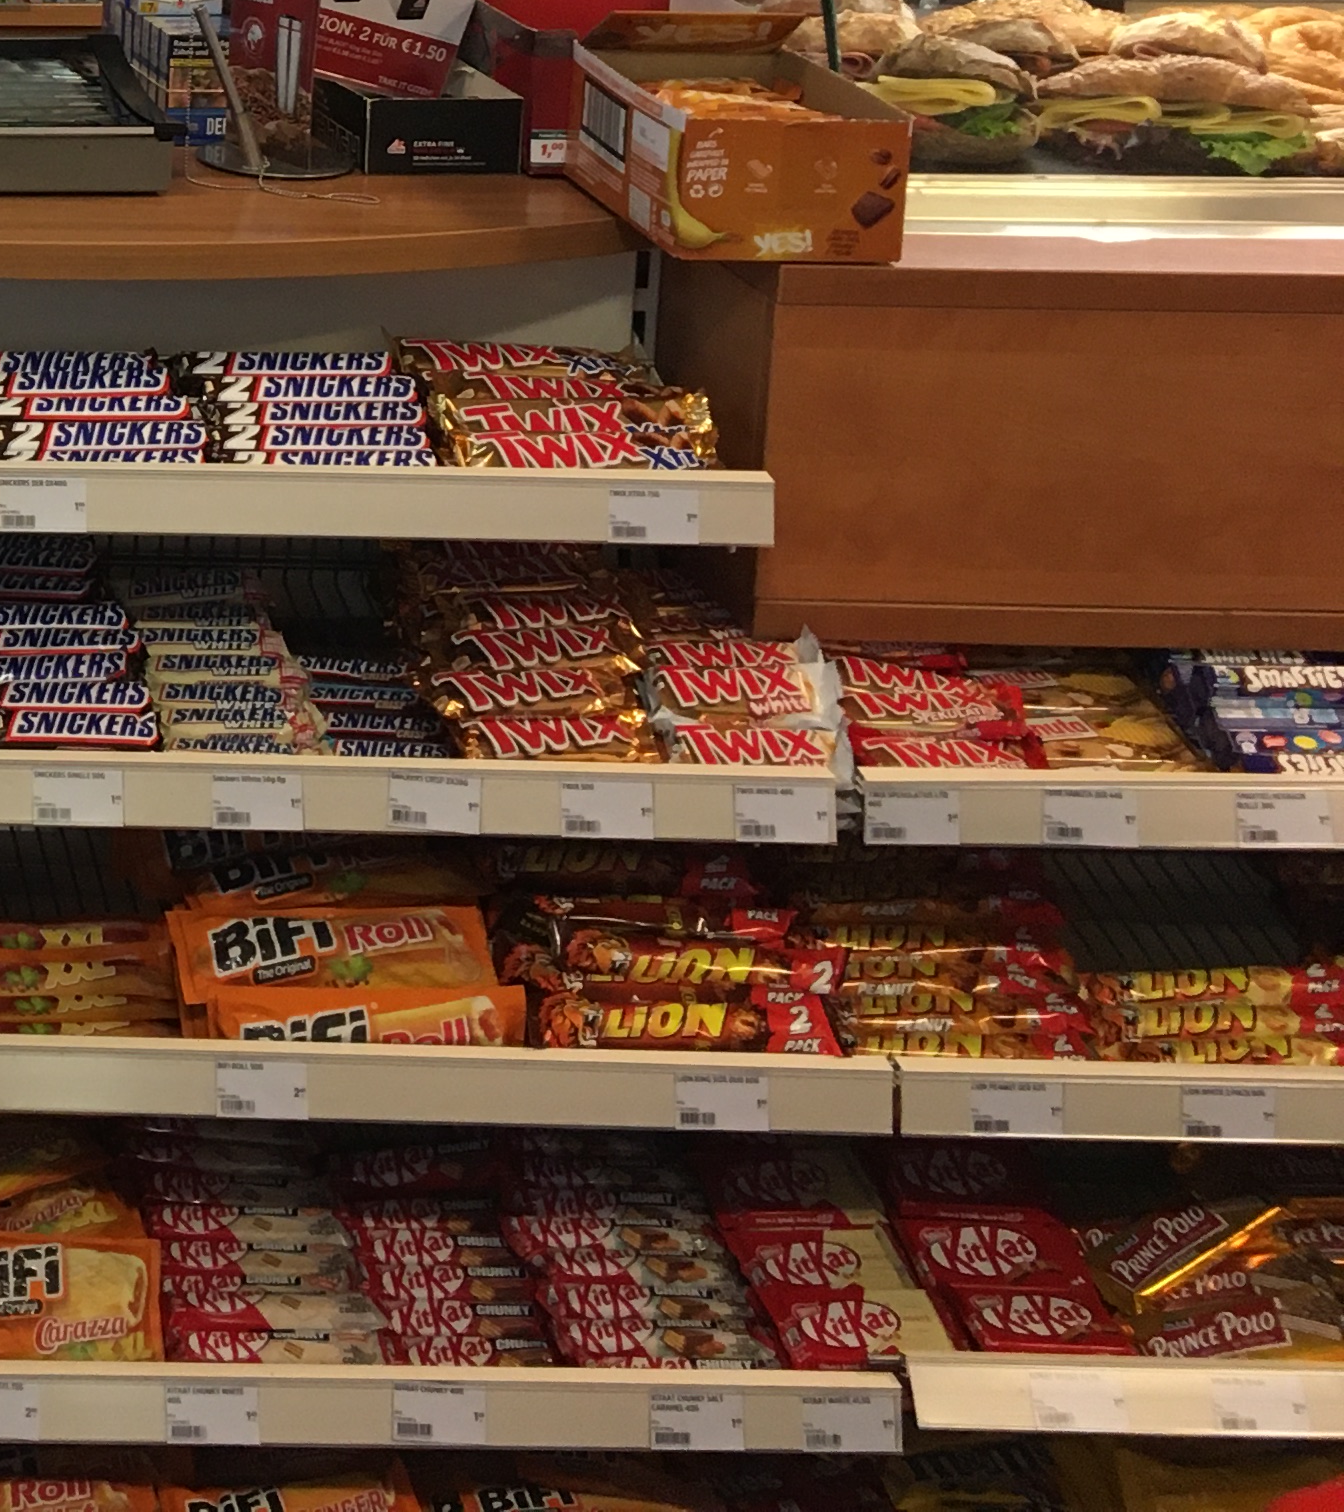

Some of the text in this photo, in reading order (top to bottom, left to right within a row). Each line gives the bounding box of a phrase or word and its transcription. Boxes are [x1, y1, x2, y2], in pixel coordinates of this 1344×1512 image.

[359, 27, 371, 41] 2
[373, 33, 397, 48] FÜR
[753, 229, 814, 257] YES!
[50, 420, 208, 451] SNICKERS
[21, 713, 157, 740] SNICKERS
[213, 916, 432, 976] BiFi Roll
[604, 1003, 728, 1039] LION
[933, 1227, 1037, 1276] KitKat
[1117, 1205, 1204, 1283] PRINCE POLO
[476, 1303, 530, 1317] CHUNKY
[33, 1314, 130, 1354] Carazza
